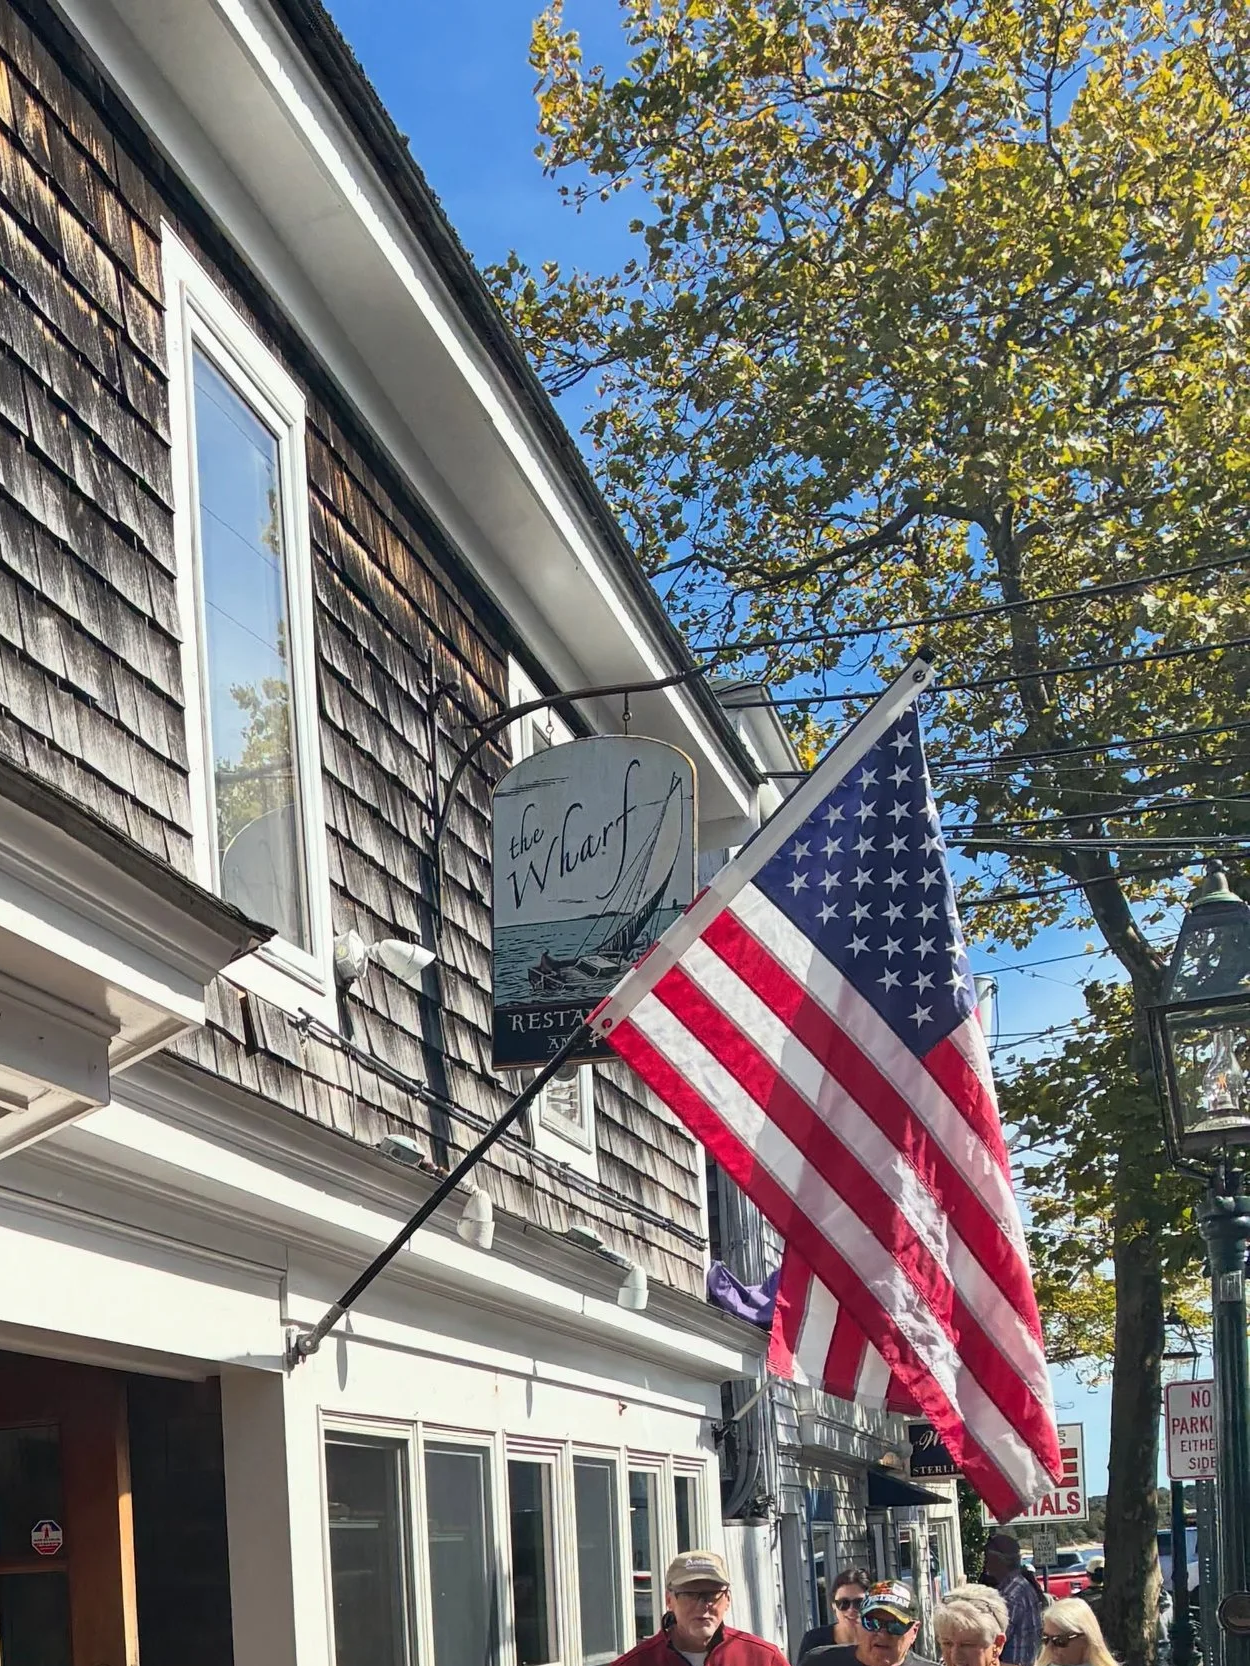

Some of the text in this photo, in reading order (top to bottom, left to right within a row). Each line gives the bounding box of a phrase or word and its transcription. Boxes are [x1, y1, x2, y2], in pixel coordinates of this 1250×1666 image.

[506, 759, 640, 909] Wharf
[509, 803, 544, 860] the
[508, 1008, 592, 1033] RESTA
[1191, 1390, 1211, 1408] NO
[1172, 1415, 1213, 1435] PARKI
[1181, 1438, 1216, 1452] EITHE
[913, 1464, 955, 1475] STERLI
